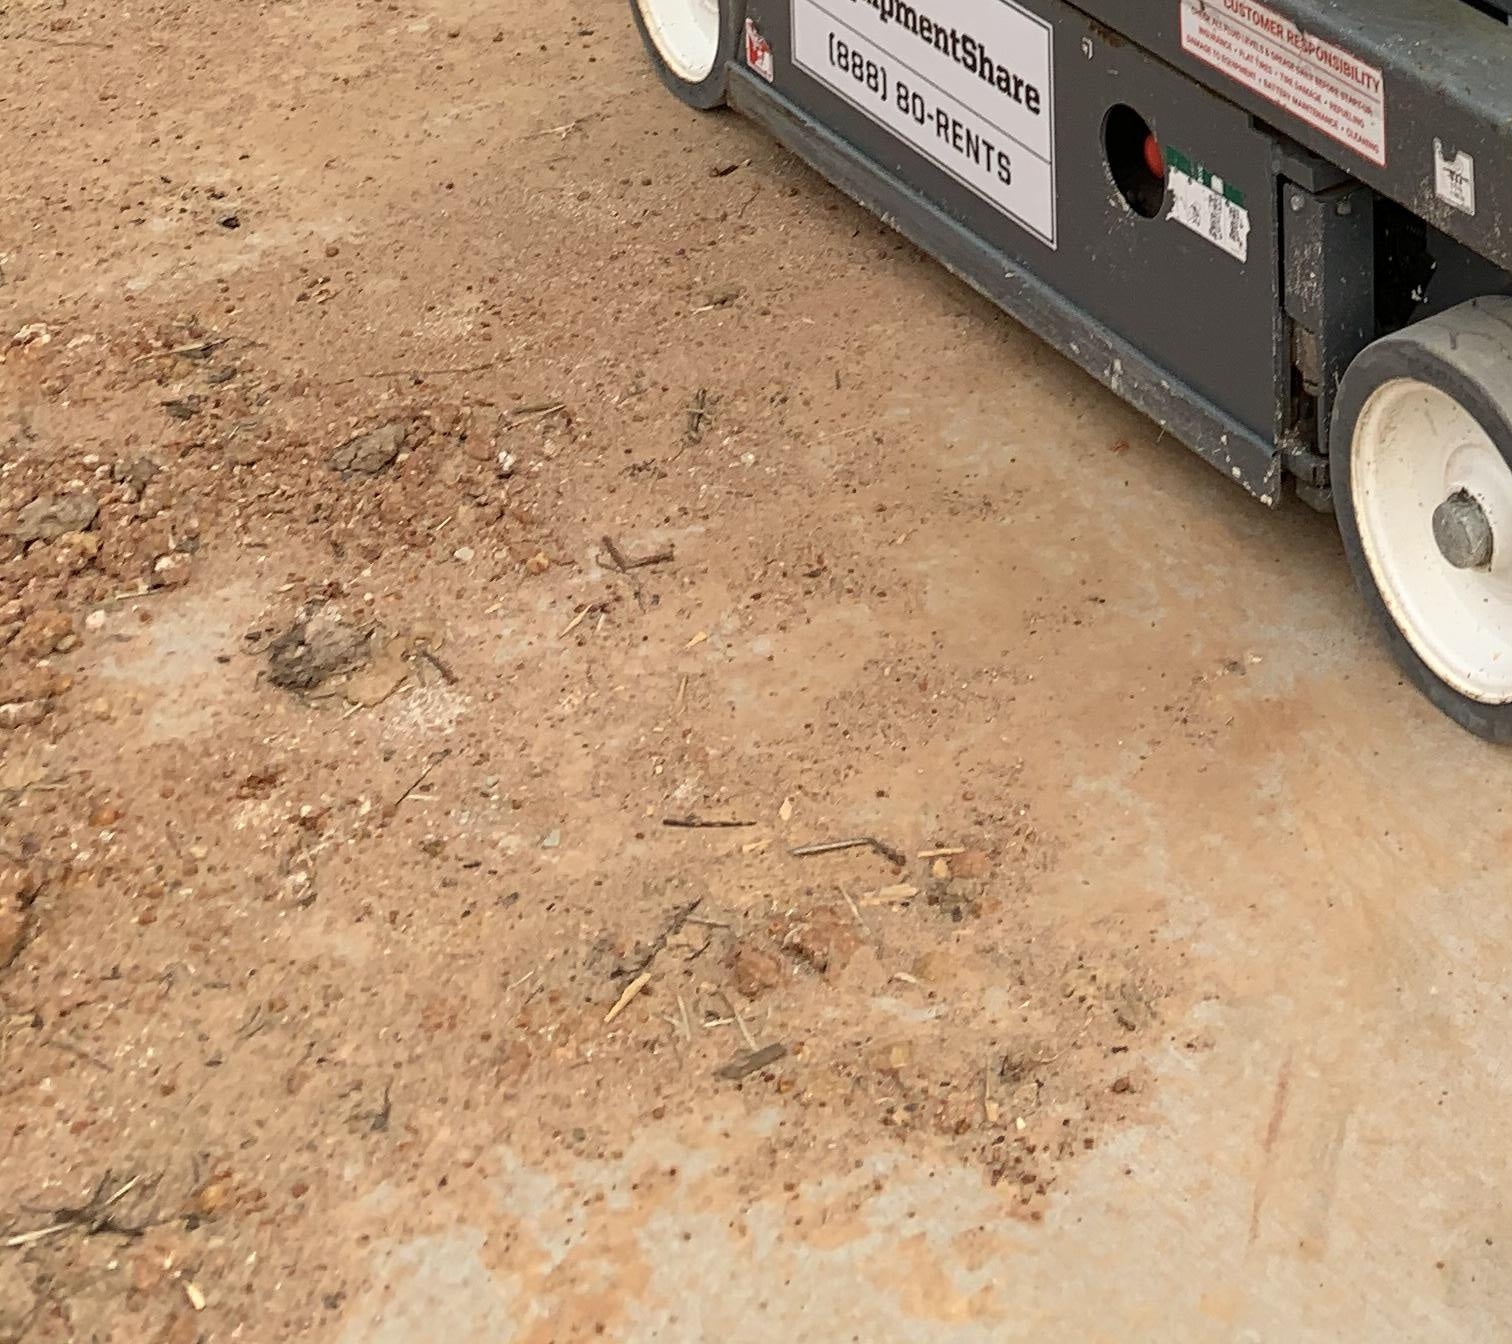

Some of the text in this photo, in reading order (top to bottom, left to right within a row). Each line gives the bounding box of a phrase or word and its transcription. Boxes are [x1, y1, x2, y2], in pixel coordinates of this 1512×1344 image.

[828, 30, 1012, 187] (888) 80-RENTS
[1286, 29, 1381, 94] RESPONSIBILITY
